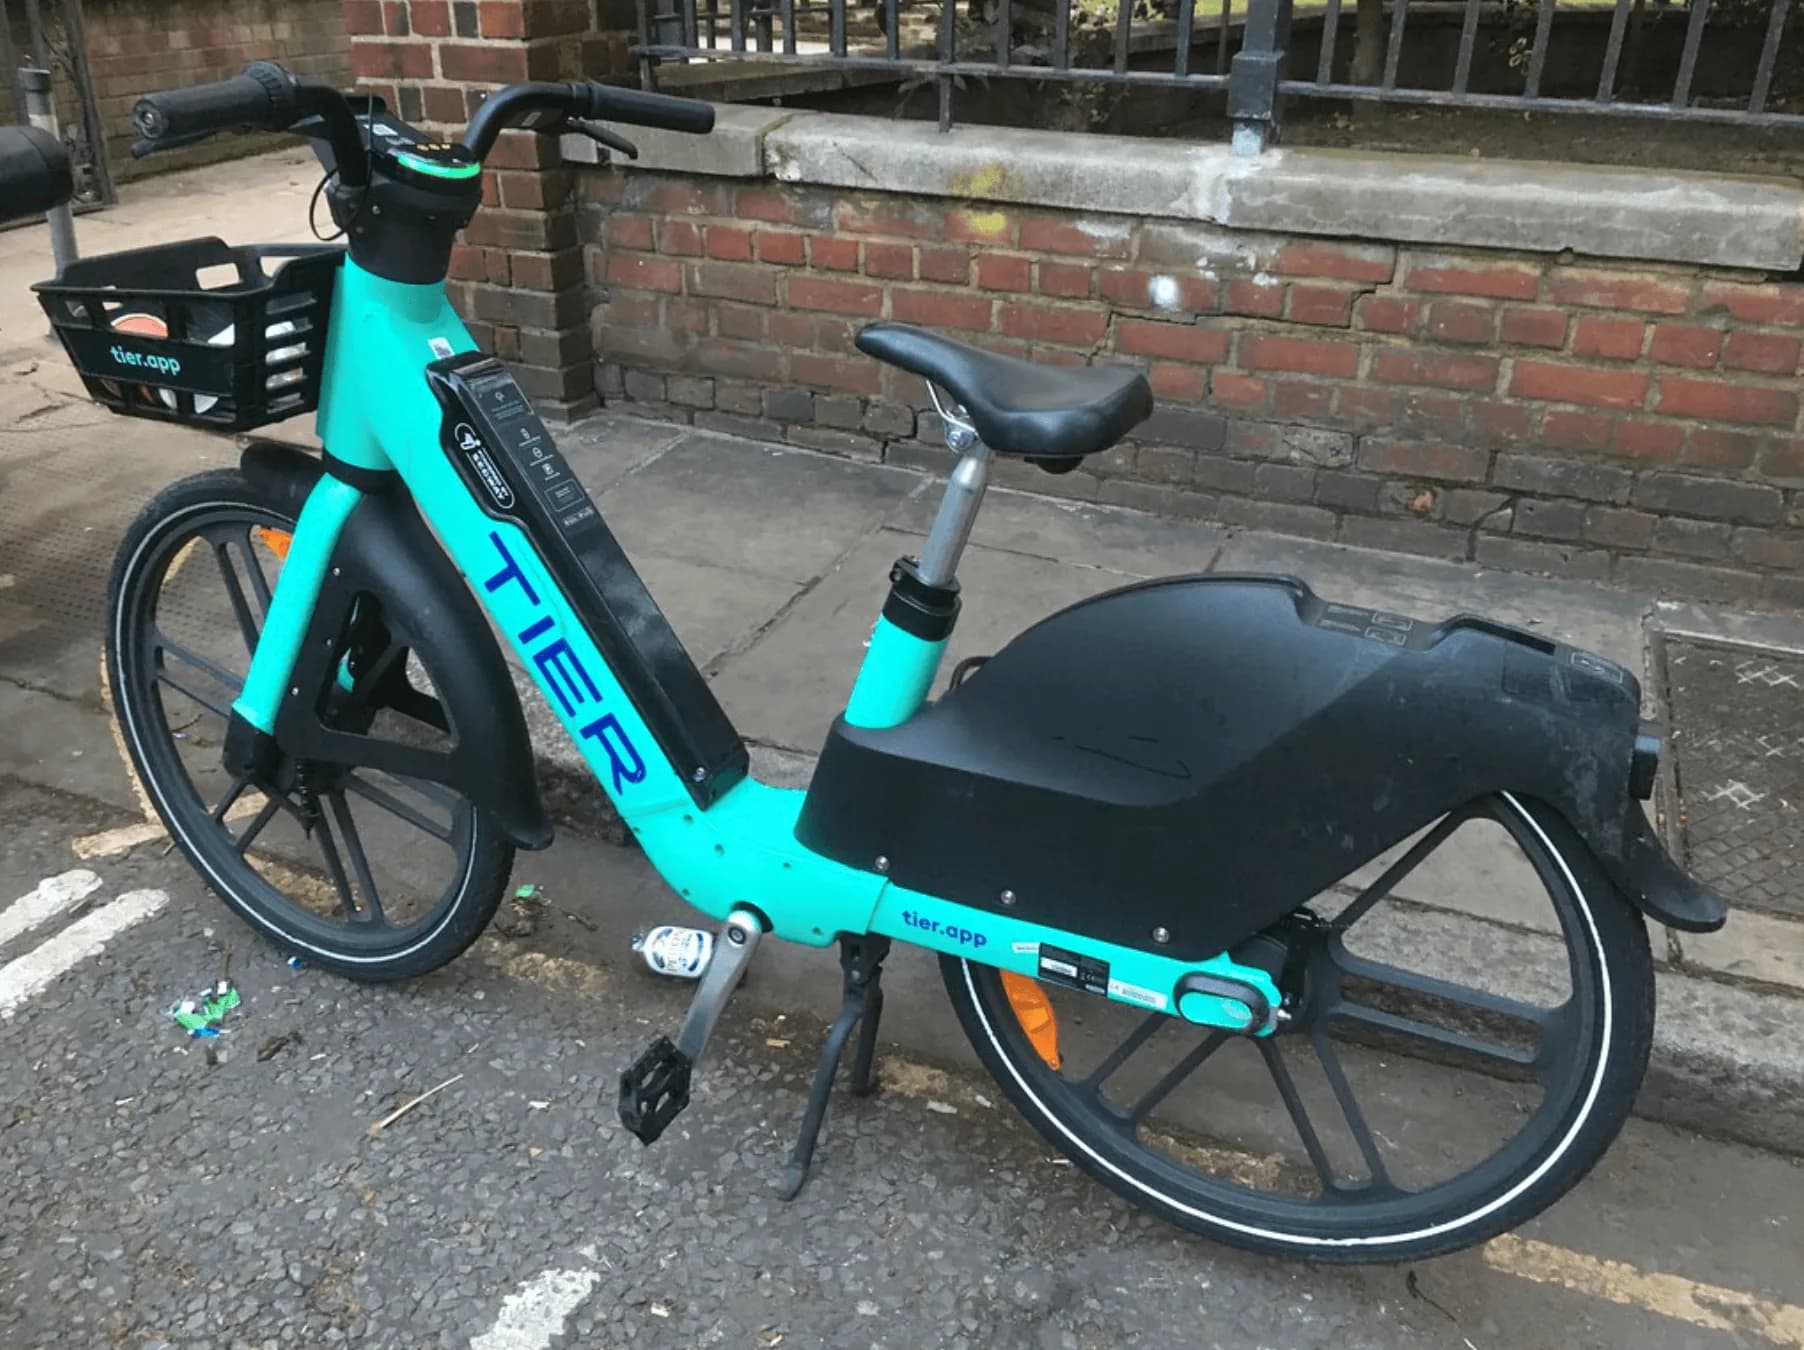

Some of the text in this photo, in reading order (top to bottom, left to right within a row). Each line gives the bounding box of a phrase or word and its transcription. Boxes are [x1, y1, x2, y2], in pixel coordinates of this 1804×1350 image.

[110, 345, 181, 375] tier.app
[484, 530, 647, 796] TIER
[902, 909, 987, 948] tier.app
